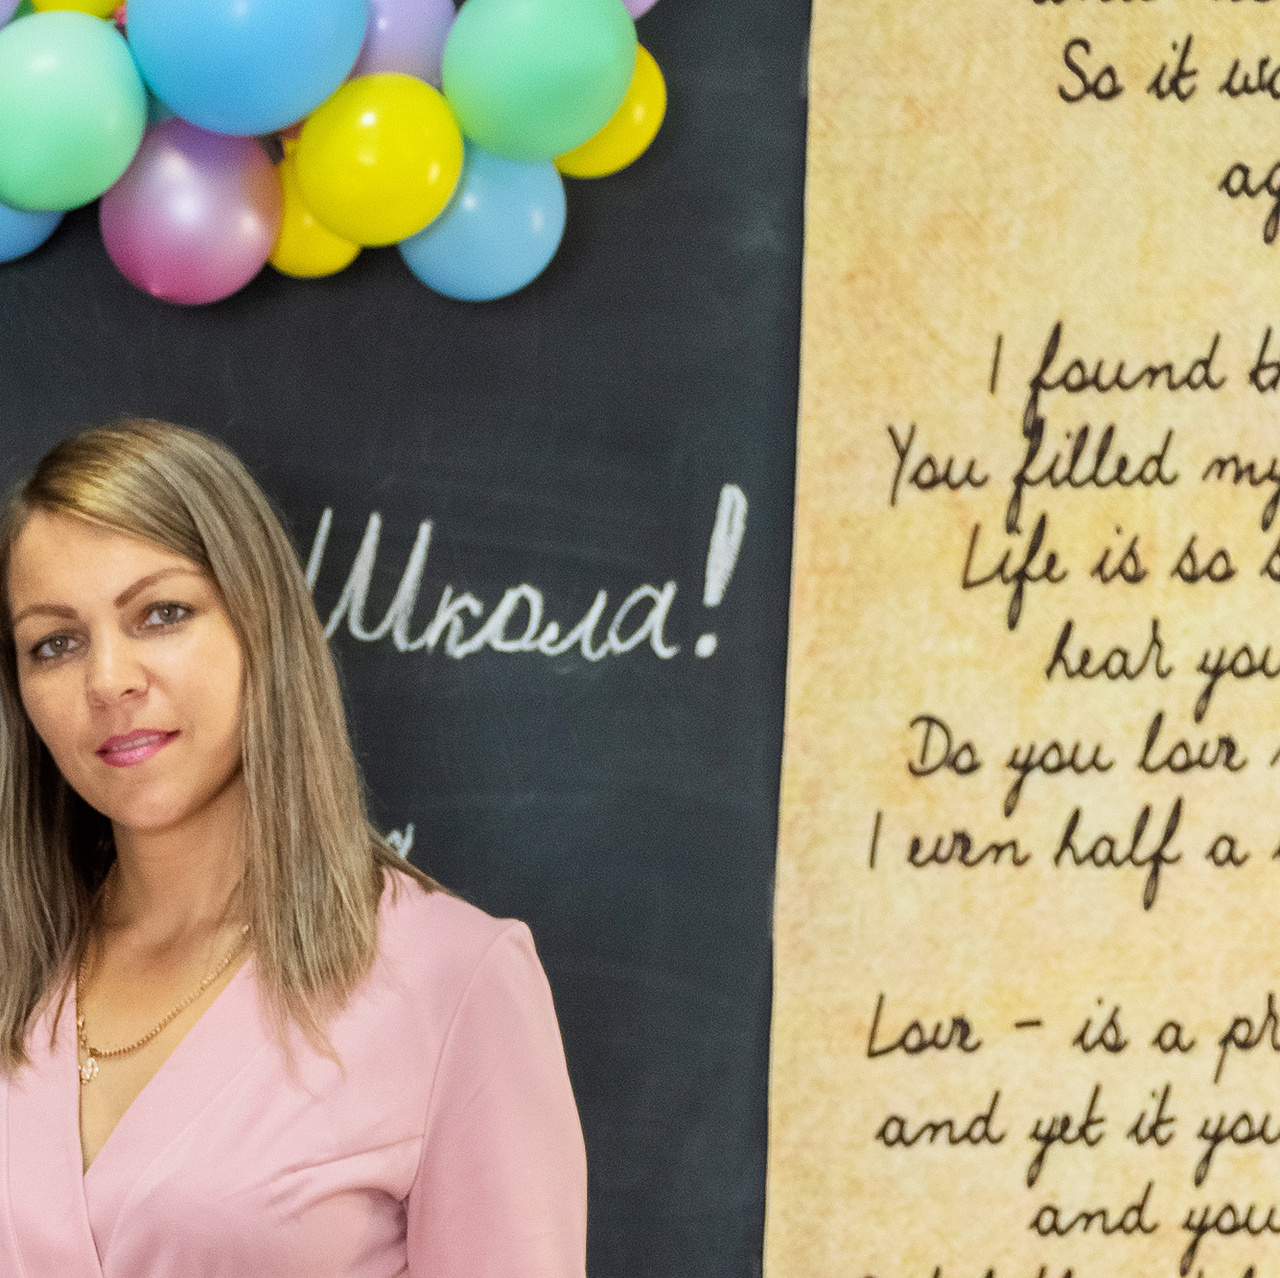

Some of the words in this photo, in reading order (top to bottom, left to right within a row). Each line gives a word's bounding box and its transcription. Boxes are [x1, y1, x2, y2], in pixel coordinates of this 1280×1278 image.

[1058, 37, 1123, 102] So
[1147, 33, 1198, 101] it
[988, 333, 1004, 395] I
[1022, 319, 1226, 437] found
[887, 423, 989, 507] You
[1005, 416, 1179, 534] filled
[962, 512, 1069, 631] Life
[1091, 524, 1148, 583] is
[1171, 533, 1237, 583] so
[1045, 616, 1174, 681] hear
[908, 713, 982, 777] Do
[1006, 741, 1116, 818] you
[1137, 709, 1248, 773] love
[869, 810, 883, 869] I
[1054, 796, 1183, 911] half
[1206, 832, 1250, 868] a
[867, 992, 983, 1059] Love
[1072, 996, 1129, 1053] is
[1151, 1019, 1197, 1053] a
[874, 1090, 1008, 1148] and
[1026, 1083, 1107, 1189] yet
[1126, 1083, 1177, 1146] it
[1028, 1180, 1160, 1237] and
